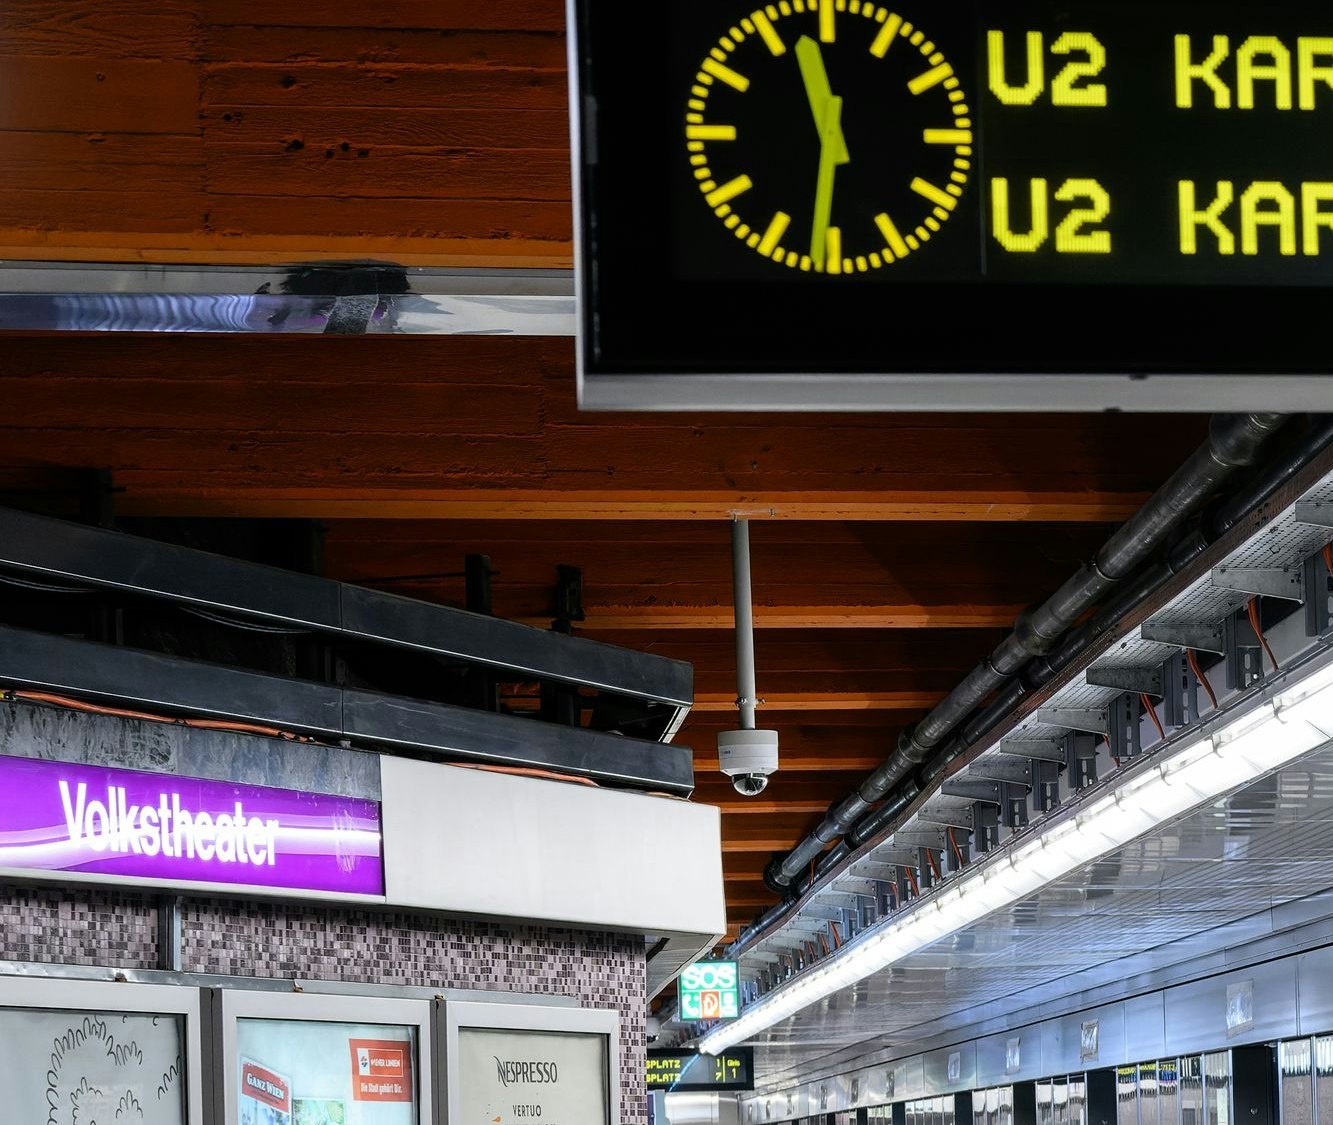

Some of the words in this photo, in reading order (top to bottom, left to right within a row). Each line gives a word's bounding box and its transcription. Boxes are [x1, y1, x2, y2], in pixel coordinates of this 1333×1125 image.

[988, 31, 1107, 107] U2
[992, 177, 1112, 254] U2
[58, 780, 279, 866] Volkstheater
[684, 964, 736, 989] SOS
[493, 1055, 558, 1088] NESPRESSO
[731, 1067, 736, 1079] 1
[512, 1104, 542, 1117] VERTUO
